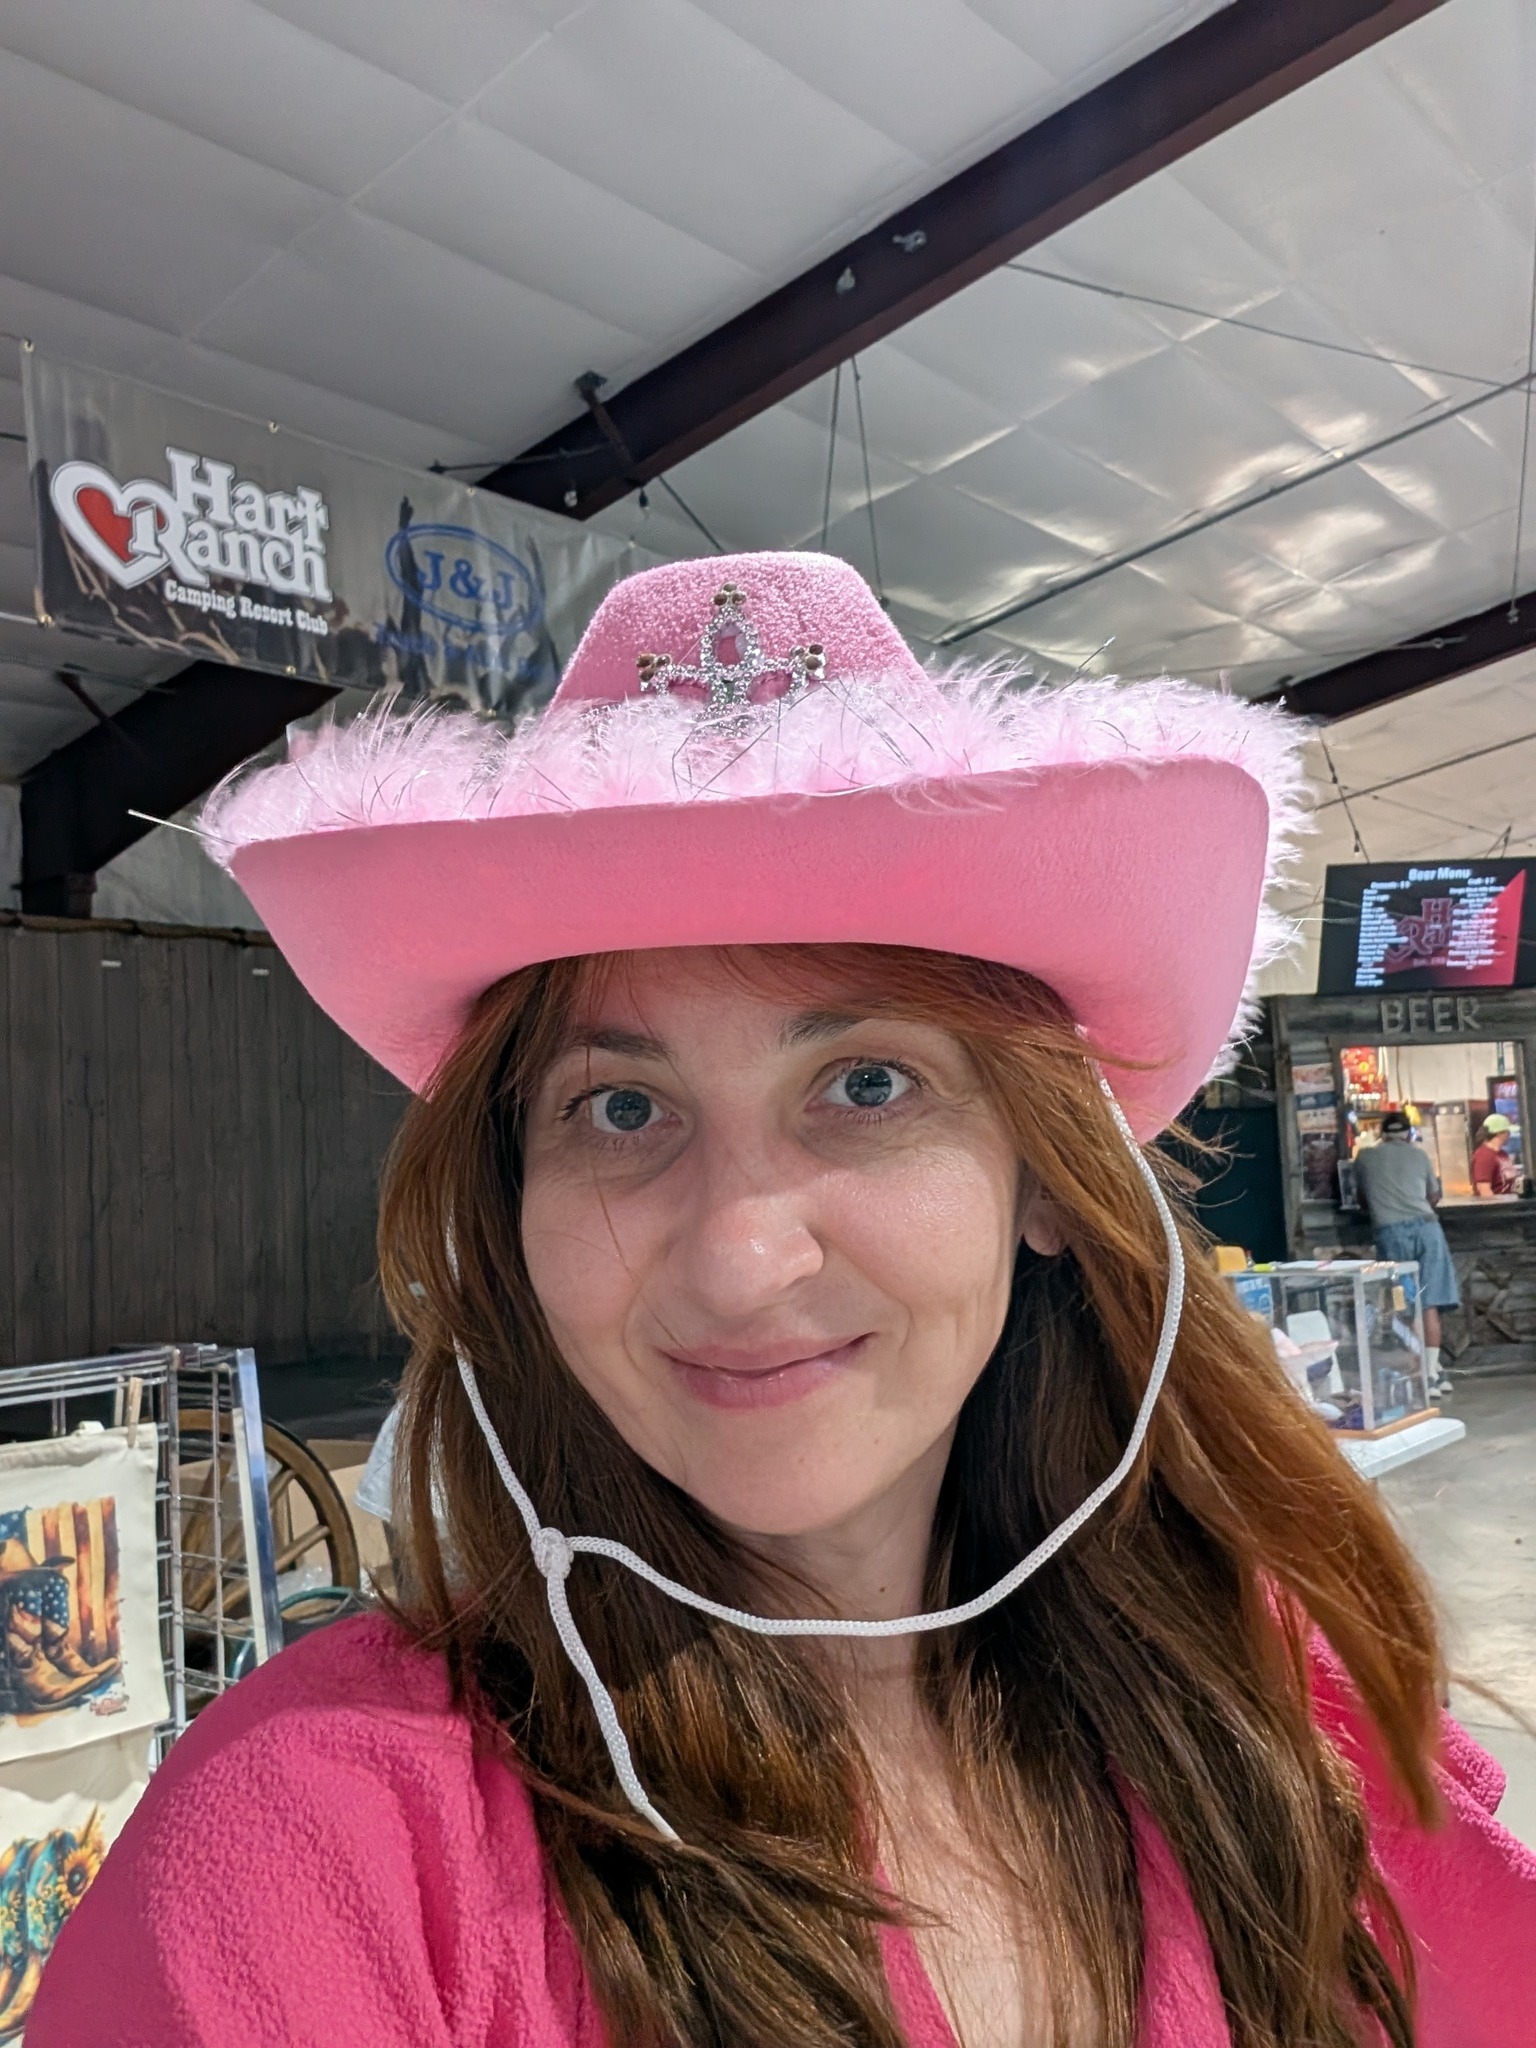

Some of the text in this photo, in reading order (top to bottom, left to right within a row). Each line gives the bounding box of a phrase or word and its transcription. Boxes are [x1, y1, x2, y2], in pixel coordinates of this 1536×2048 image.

[166, 447, 328, 550] Hart
[121, 478, 333, 603] Ranch
[164, 578, 329, 636] Camping Resort Club
[1408, 867, 1471, 881] Beer Menu
[1381, 997, 1480, 1033] BEER
